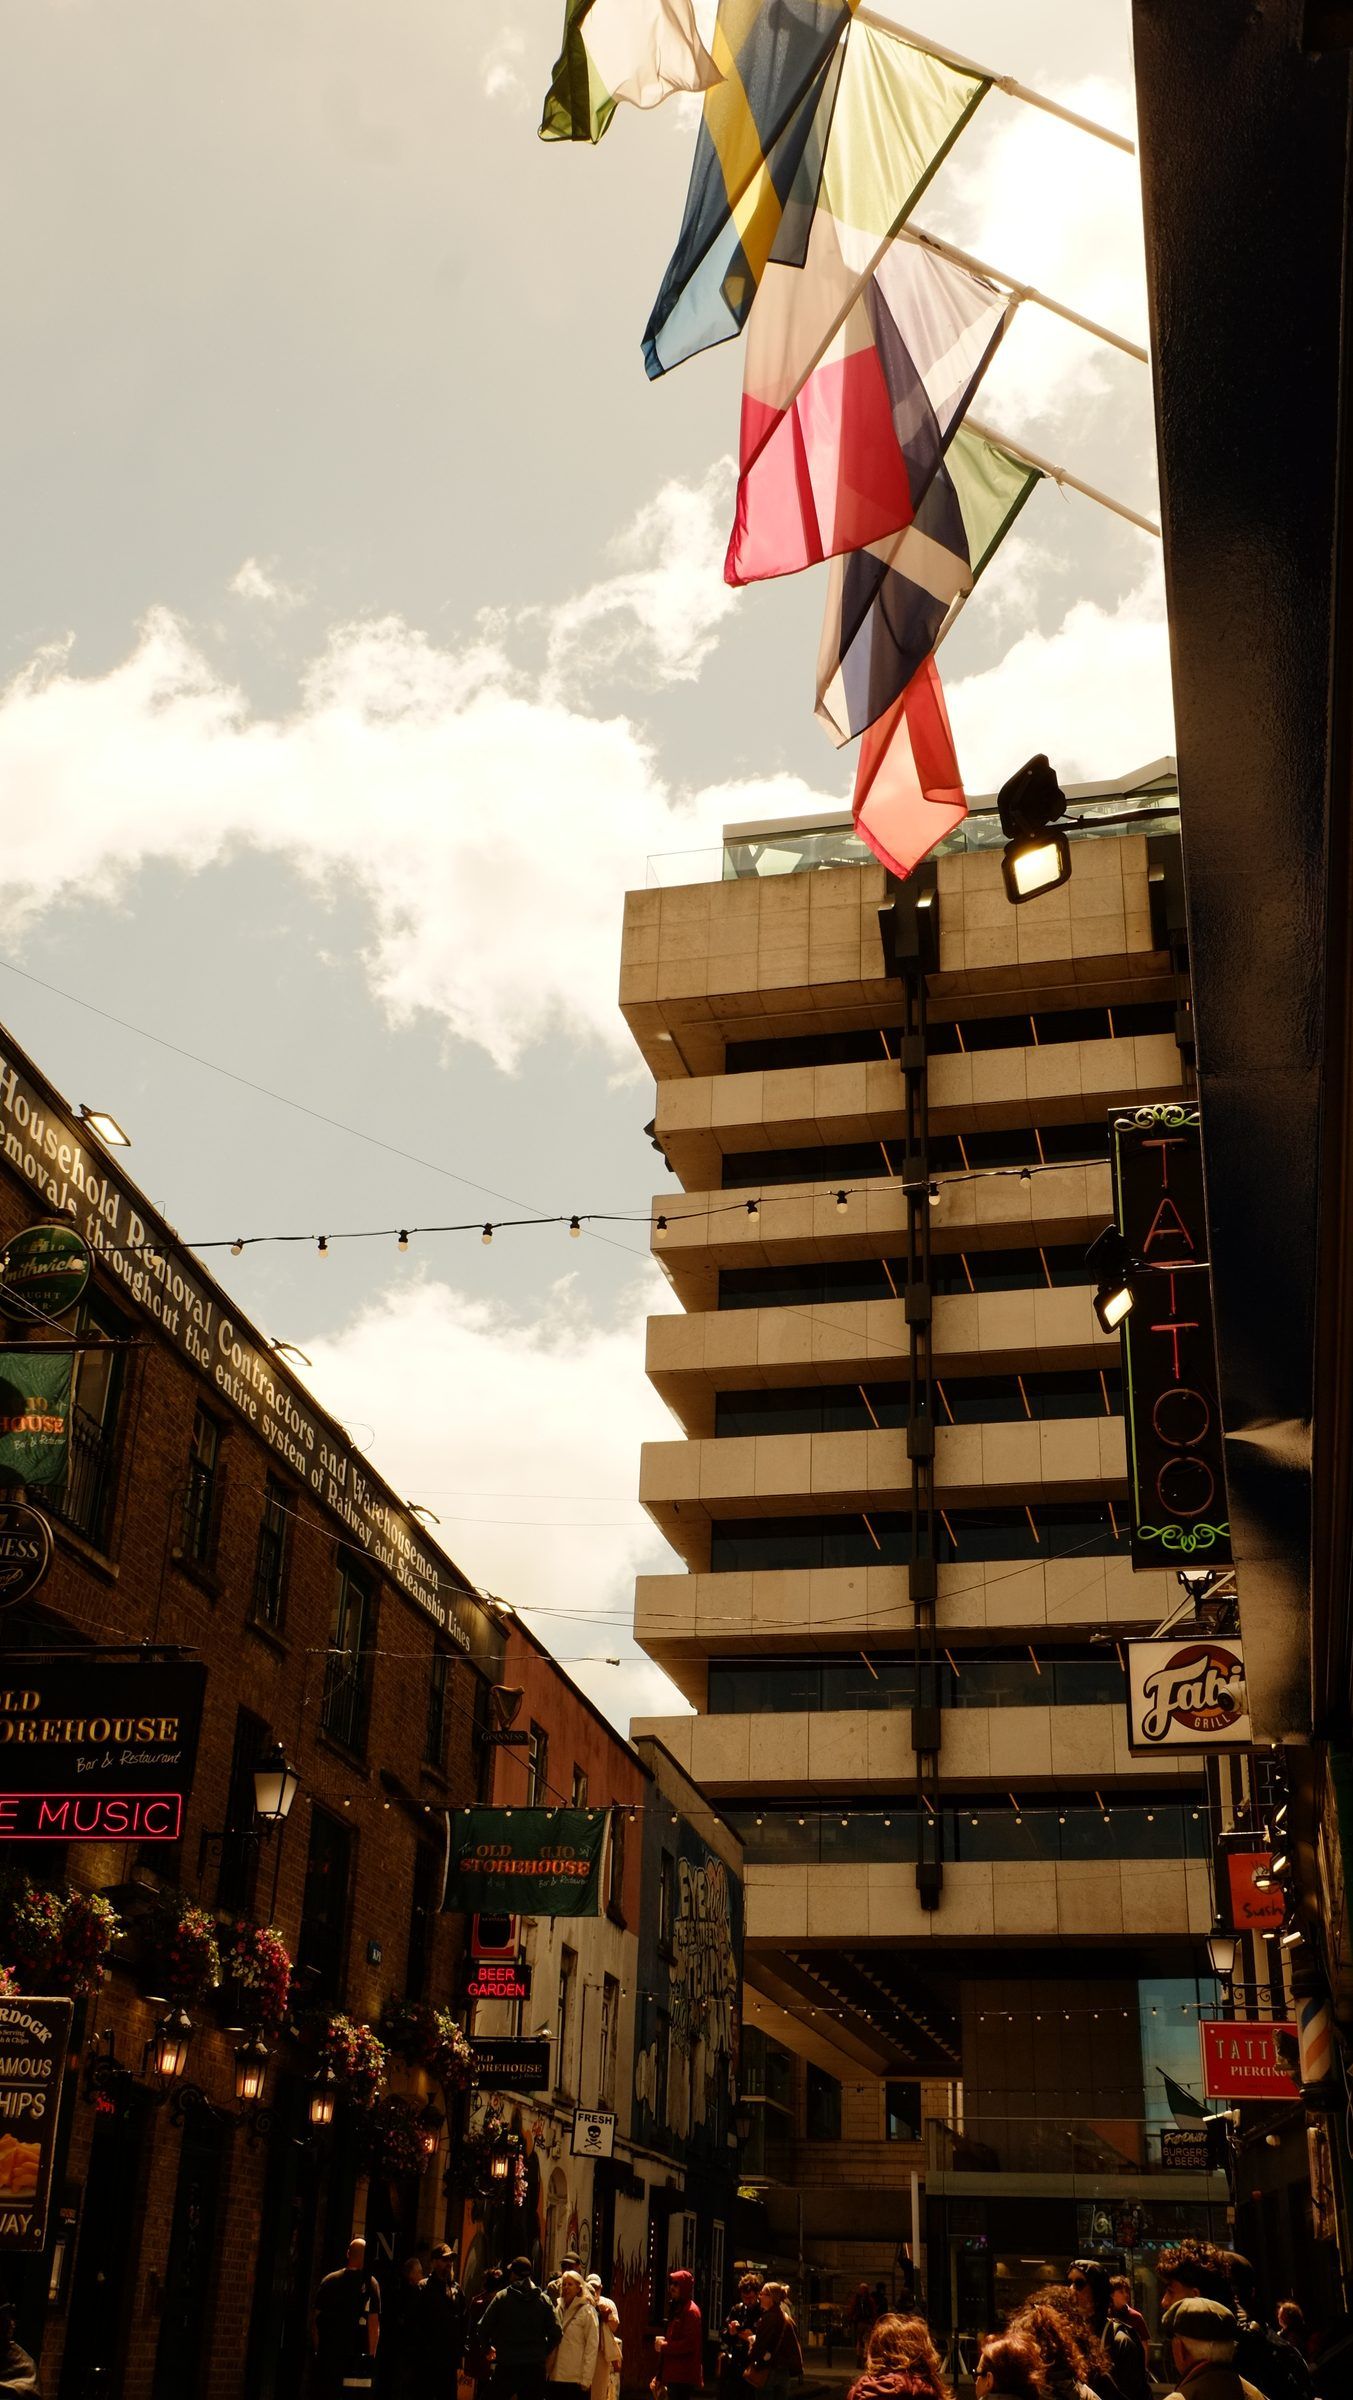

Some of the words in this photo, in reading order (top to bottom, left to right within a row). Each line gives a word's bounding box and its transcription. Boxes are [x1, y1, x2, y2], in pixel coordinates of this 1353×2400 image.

[0, 1057, 120, 1228] Household
[127, 1210, 213, 1333] Removal
[218, 1319, 315, 1450] Contractors
[319, 1440, 347, 1486] and
[351, 1467, 439, 1591] Warehousemen
[1140, 1137, 1214, 1517] TATTOO
[86, 1214, 180, 1336] throughout
[185, 1323, 210, 1368] the
[215, 1365, 257, 1420] entire
[262, 1414, 306, 1476] system
[311, 1466, 325, 1492] of
[327, 1484, 372, 1549] Railway
[375, 1538, 393, 1570] and
[396, 1556, 445, 1627] Steamship
[448, 1609, 471, 1651] Lines
[0, 1690, 41, 1712] LD
[1194, 1713, 1231, 1729] GRILL
[0, 1718, 179, 1743] OREHOUSE
[76, 1756, 98, 1773] Bar
[101, 1750, 114, 1769] &
[119, 1749, 182, 1766] Restaurant
[38, 1800, 171, 1832] MUSIC
[475, 1844, 512, 1857] OLD
[459, 1859, 591, 1876] STOREHOUSE
[1243, 1902, 1283, 1918] Sush
[478, 1967, 515, 1981] BEER
[467, 1982, 525, 1997] GARDEN
[1215, 2040, 1268, 2060] TATT
[578, 2112, 613, 2125] FRESH
[1163, 2146, 1209, 2157] BURGERS
[1175, 2157, 1207, 2167] BEERS
